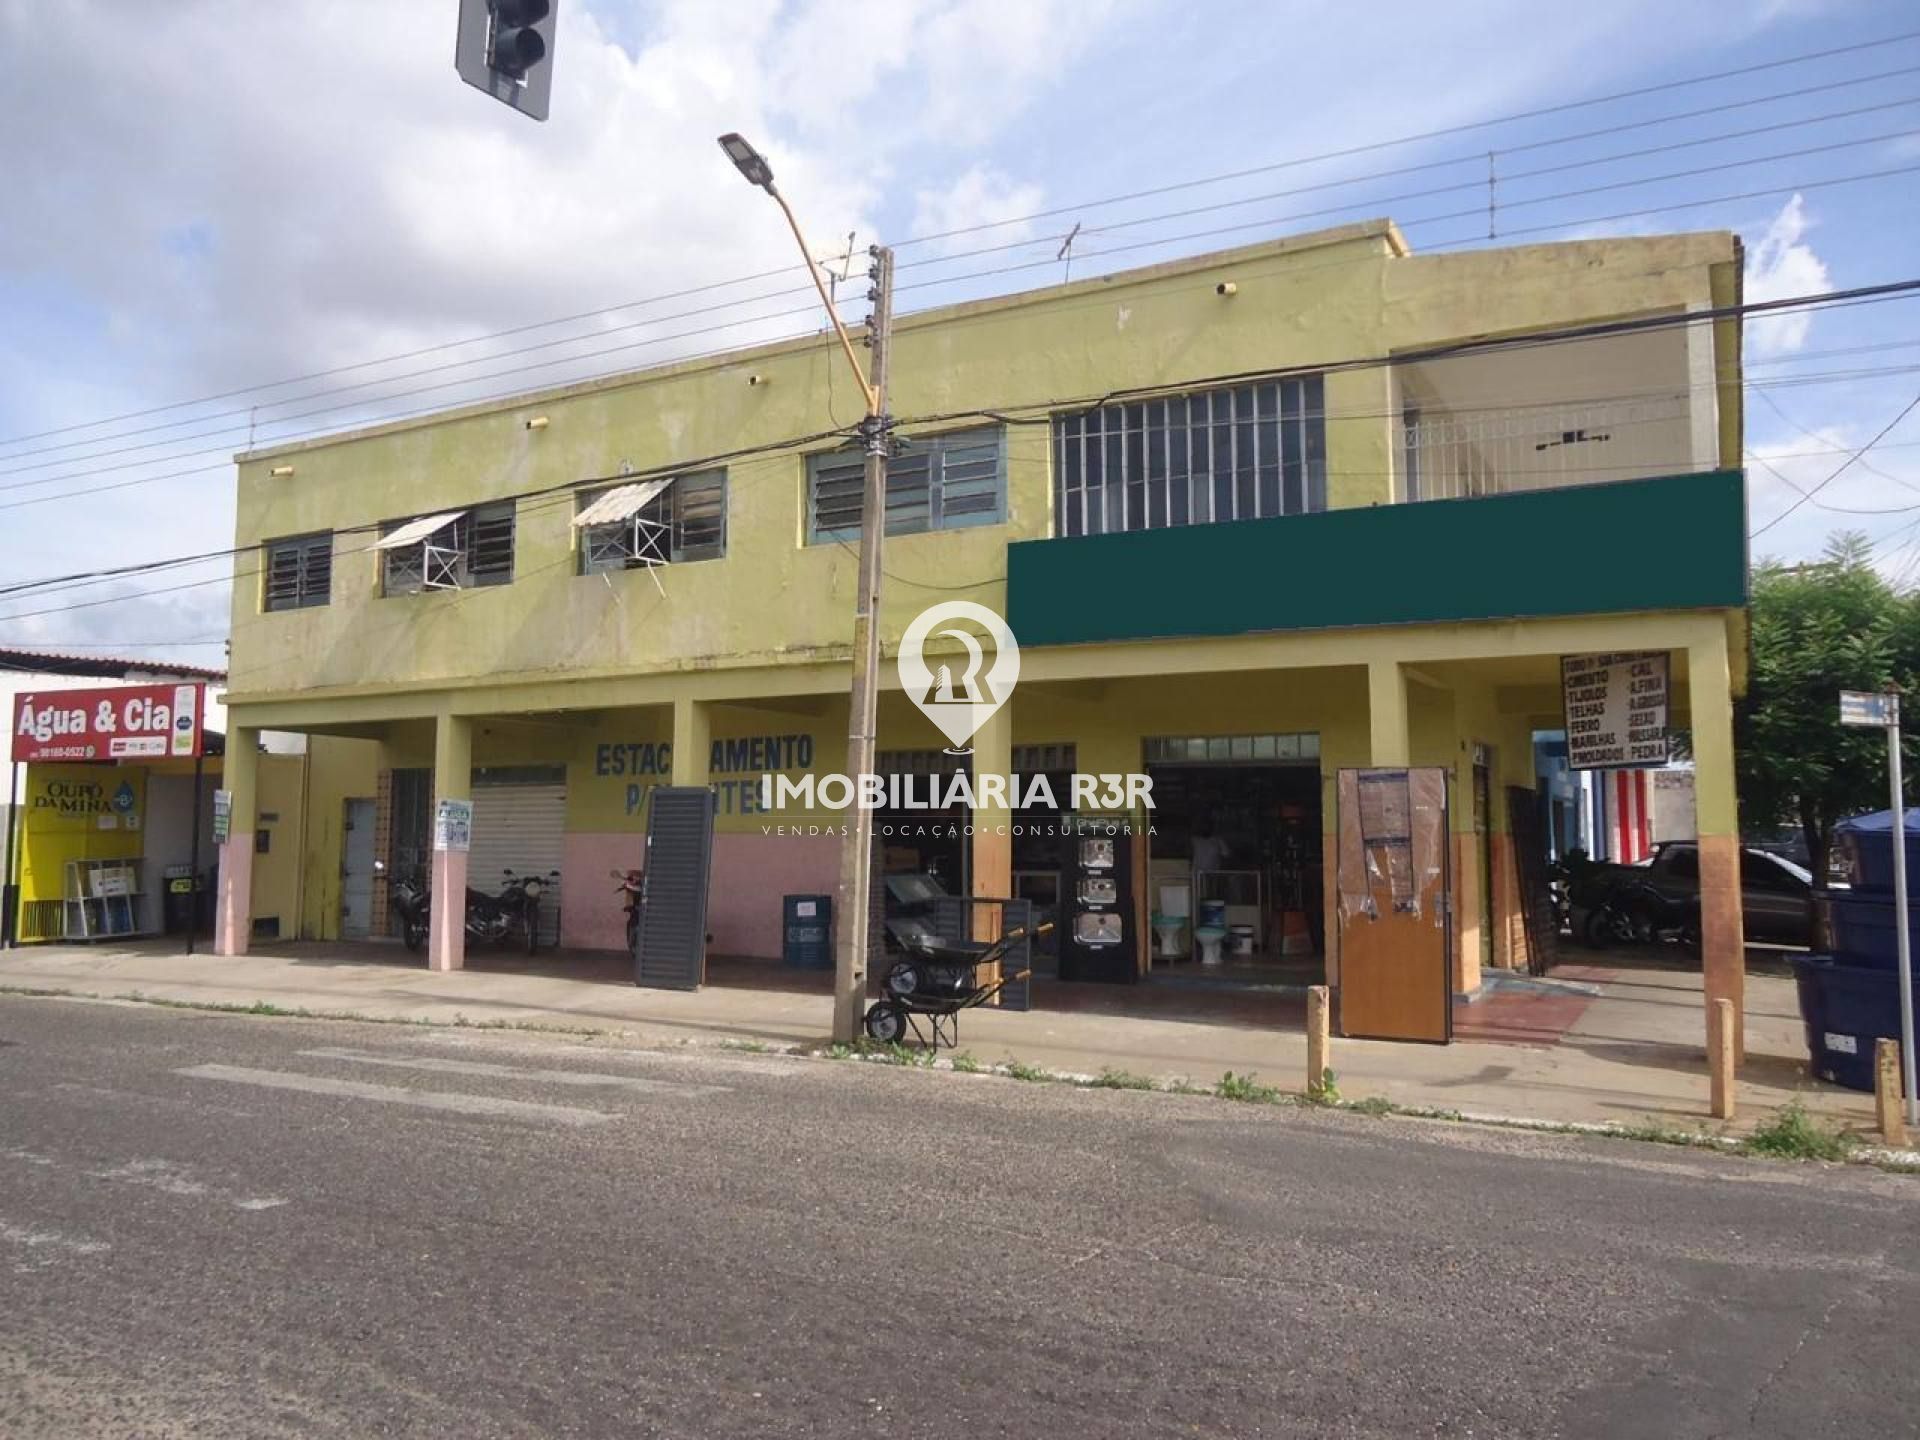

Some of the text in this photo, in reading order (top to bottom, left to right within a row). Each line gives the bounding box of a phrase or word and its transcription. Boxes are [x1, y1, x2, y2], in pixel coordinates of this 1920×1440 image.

[1569, 687, 1608, 704] TIJOLOS
[17, 695, 170, 742] Água & Cia
[1570, 702, 1605, 718] TELHAS
[1572, 719, 1600, 734] FERRO
[596, 734, 813, 776] ESTACAMENTO
[1632, 743, 1663, 760] PEDRA
